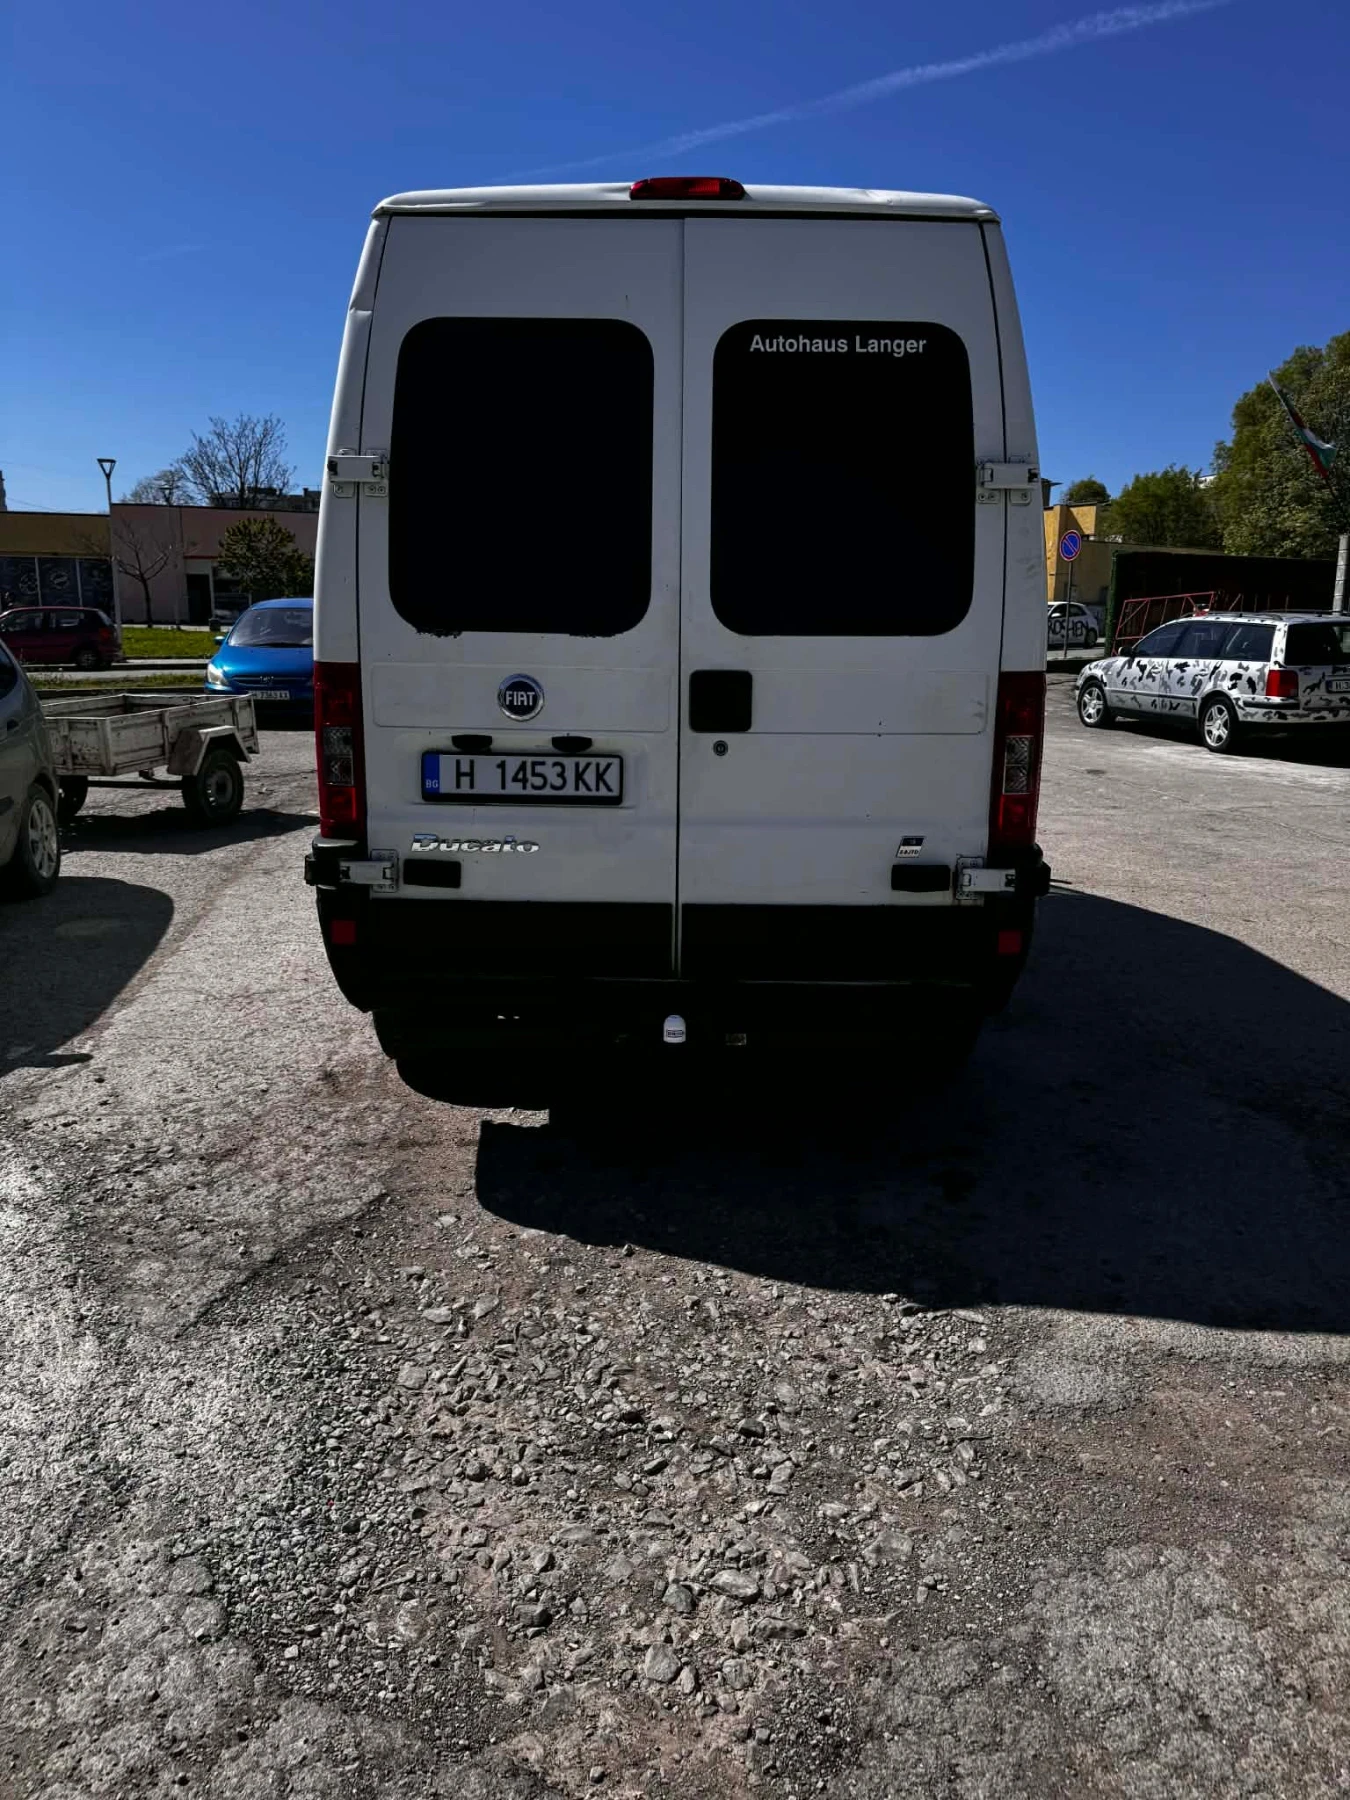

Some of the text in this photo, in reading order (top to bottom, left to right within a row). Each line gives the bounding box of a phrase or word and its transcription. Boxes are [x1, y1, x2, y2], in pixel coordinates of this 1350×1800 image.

[749, 334, 927, 358] Autohaus Langer
[505, 690, 536, 707] FIAT
[425, 779, 439, 789] BG
[455, 758, 475, 790] H
[411, 833, 540, 853] Ducato
